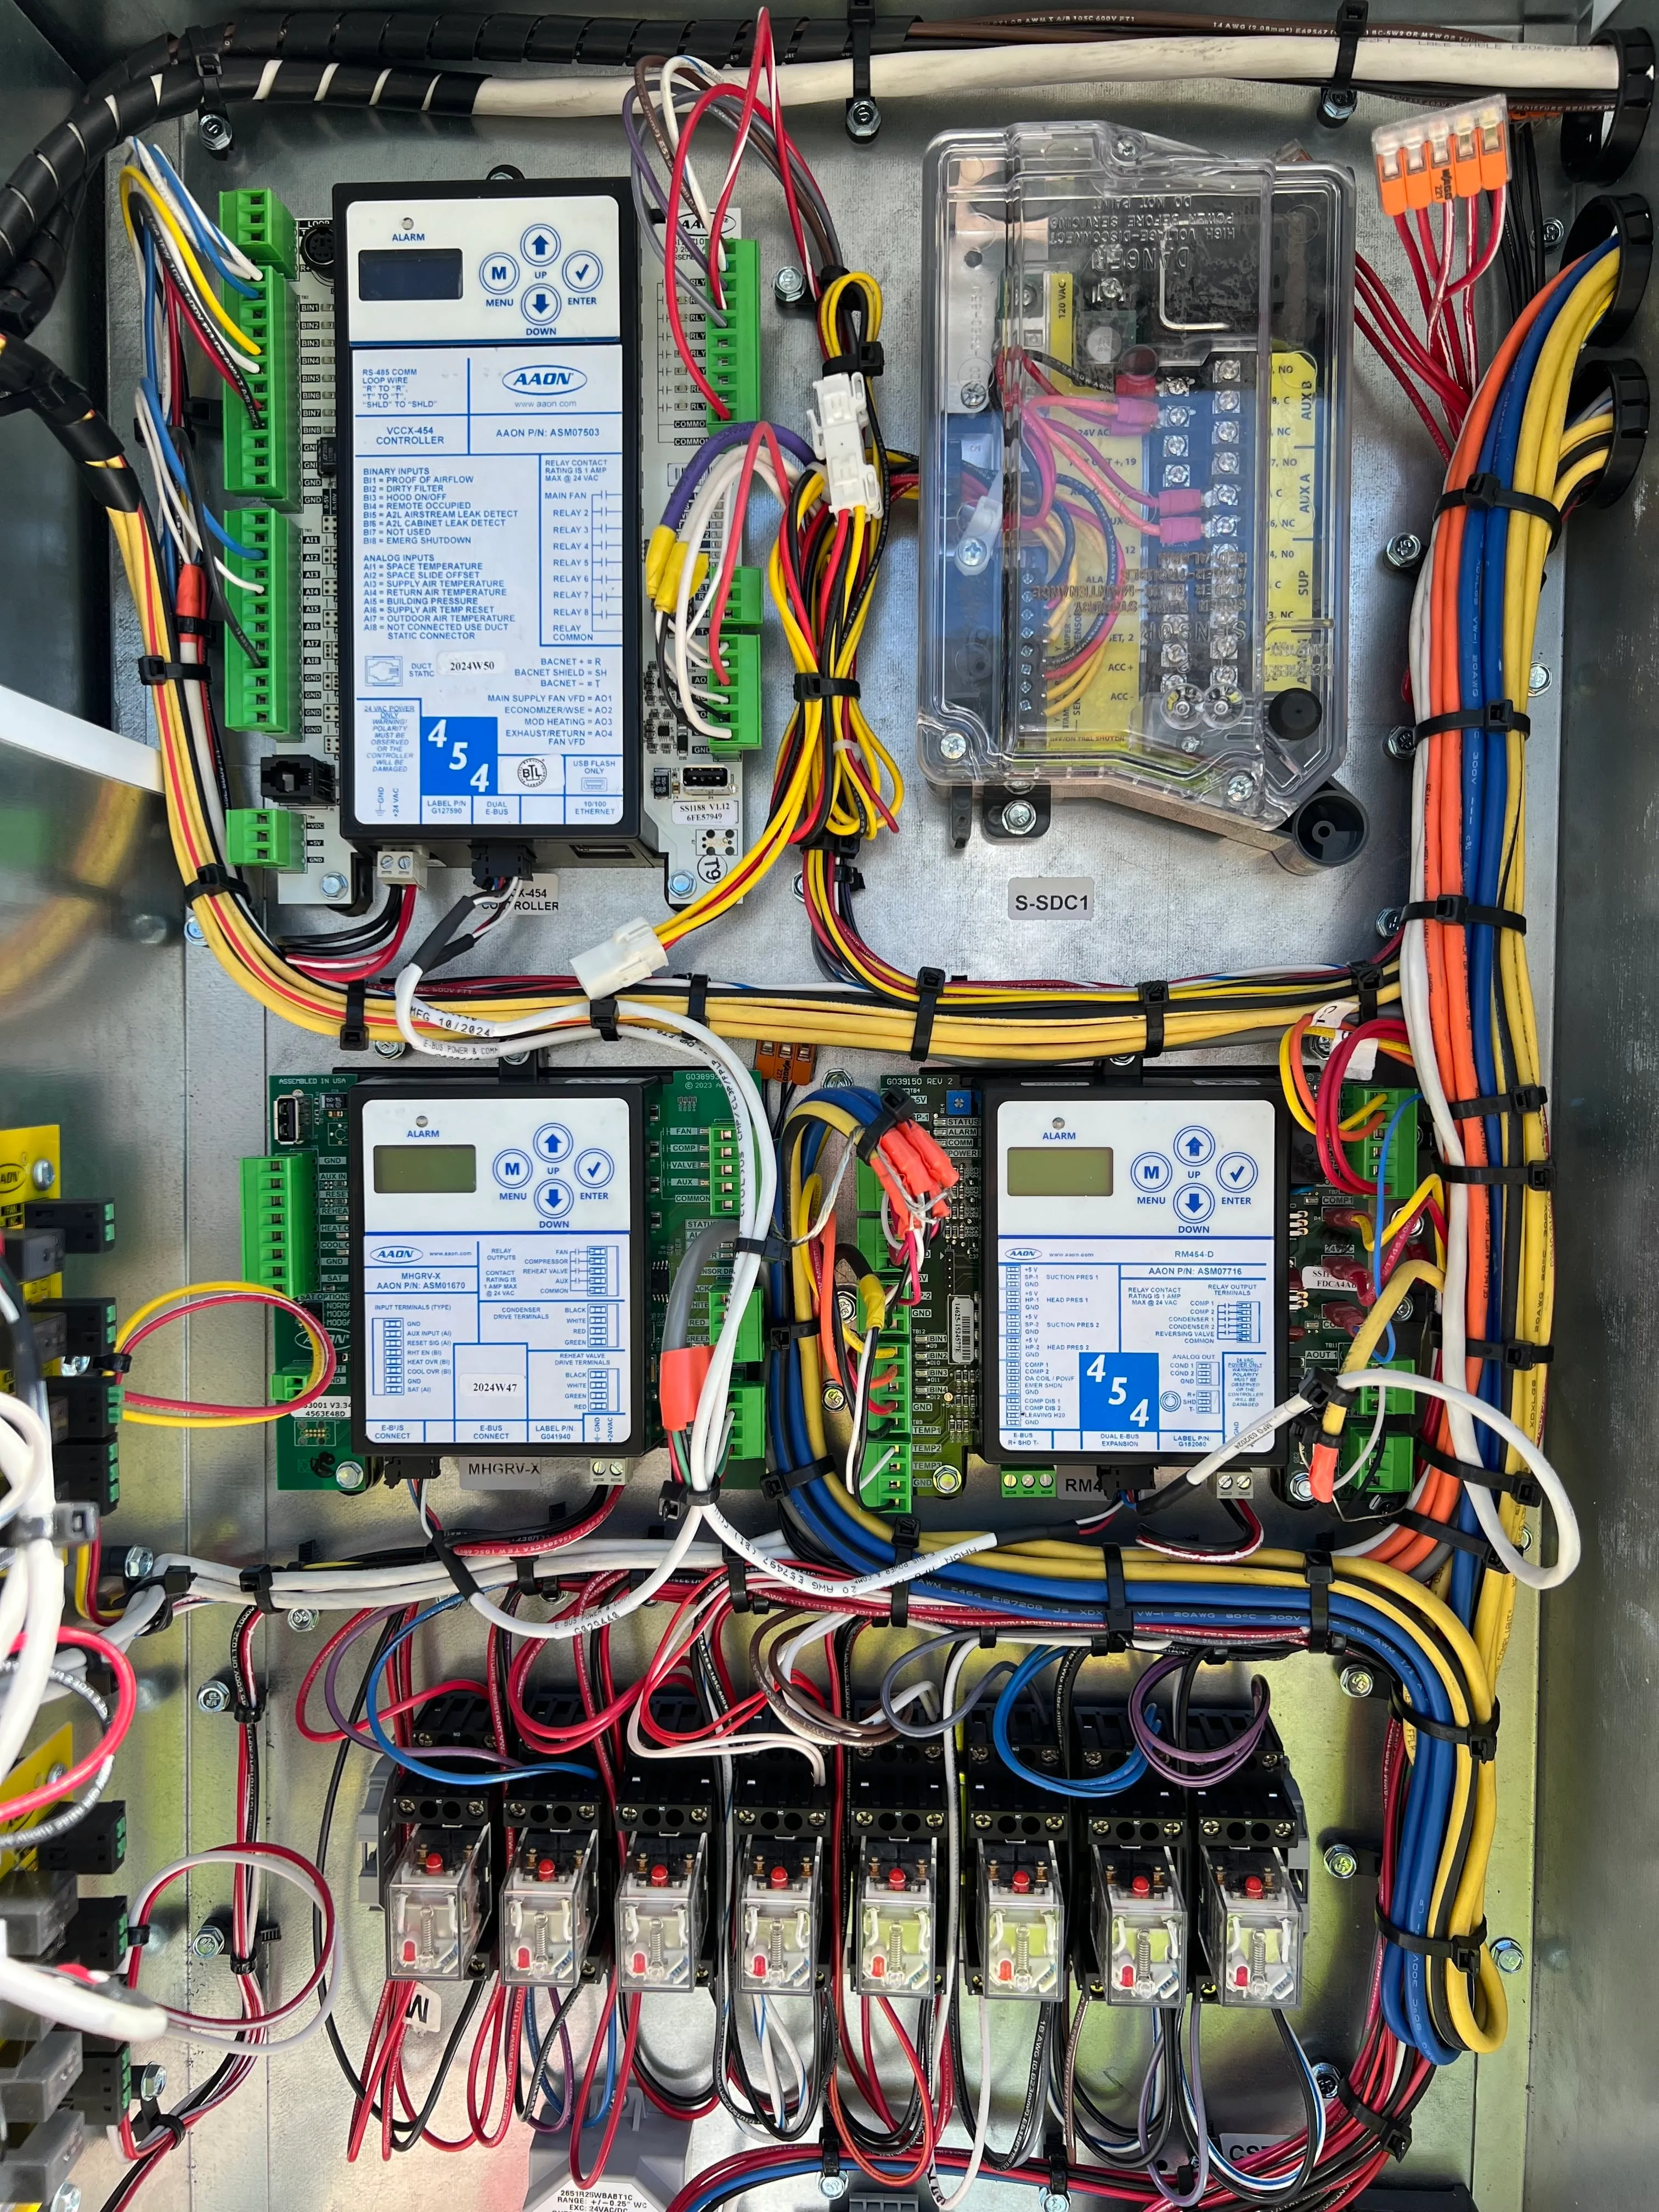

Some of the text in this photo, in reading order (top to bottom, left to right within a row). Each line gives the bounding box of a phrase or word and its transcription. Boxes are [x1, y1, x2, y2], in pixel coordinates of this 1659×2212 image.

[1050, 212, 1233, 228] POWER BEFORE SERVICING
[1050, 227, 1235, 244] HIGH VOLTAGE-DISCONNECT
[1091, 246, 1189, 270] DANGER
[492, 267, 506, 280] M
[1058, 282, 1066, 319] 120 VAC
[514, 373, 571, 385] AAON
[1301, 381, 1312, 421] AUX B
[376, 436, 444, 445] CONTROLLER
[550, 428, 600, 437] ASM07503
[1299, 570, 1308, 596] SUP
[450, 662, 494, 670] 2024W50
[428, 719, 447, 747] 4
[449, 742, 468, 770] 5
[470, 764, 489, 792] 4
[687, 812, 722, 821] 6FE57949
[1015, 894, 1088, 911] S-SDC1
[411, 1006, 490, 1036] MFG 10/2024
[424, 1041, 443, 1051] E-BUS
[448, 1044, 468, 1054] POWER
[505, 1163, 519, 1175] M
[1144, 1166, 1159, 1179] M
[1087, 1355, 1106, 1383] 4
[473, 1383, 517, 1393] 2024W47
[1108, 1377, 1127, 1405] 5
[1130, 1399, 1149, 1427] 4
[468, 1463, 540, 1475] MHGRV-X
